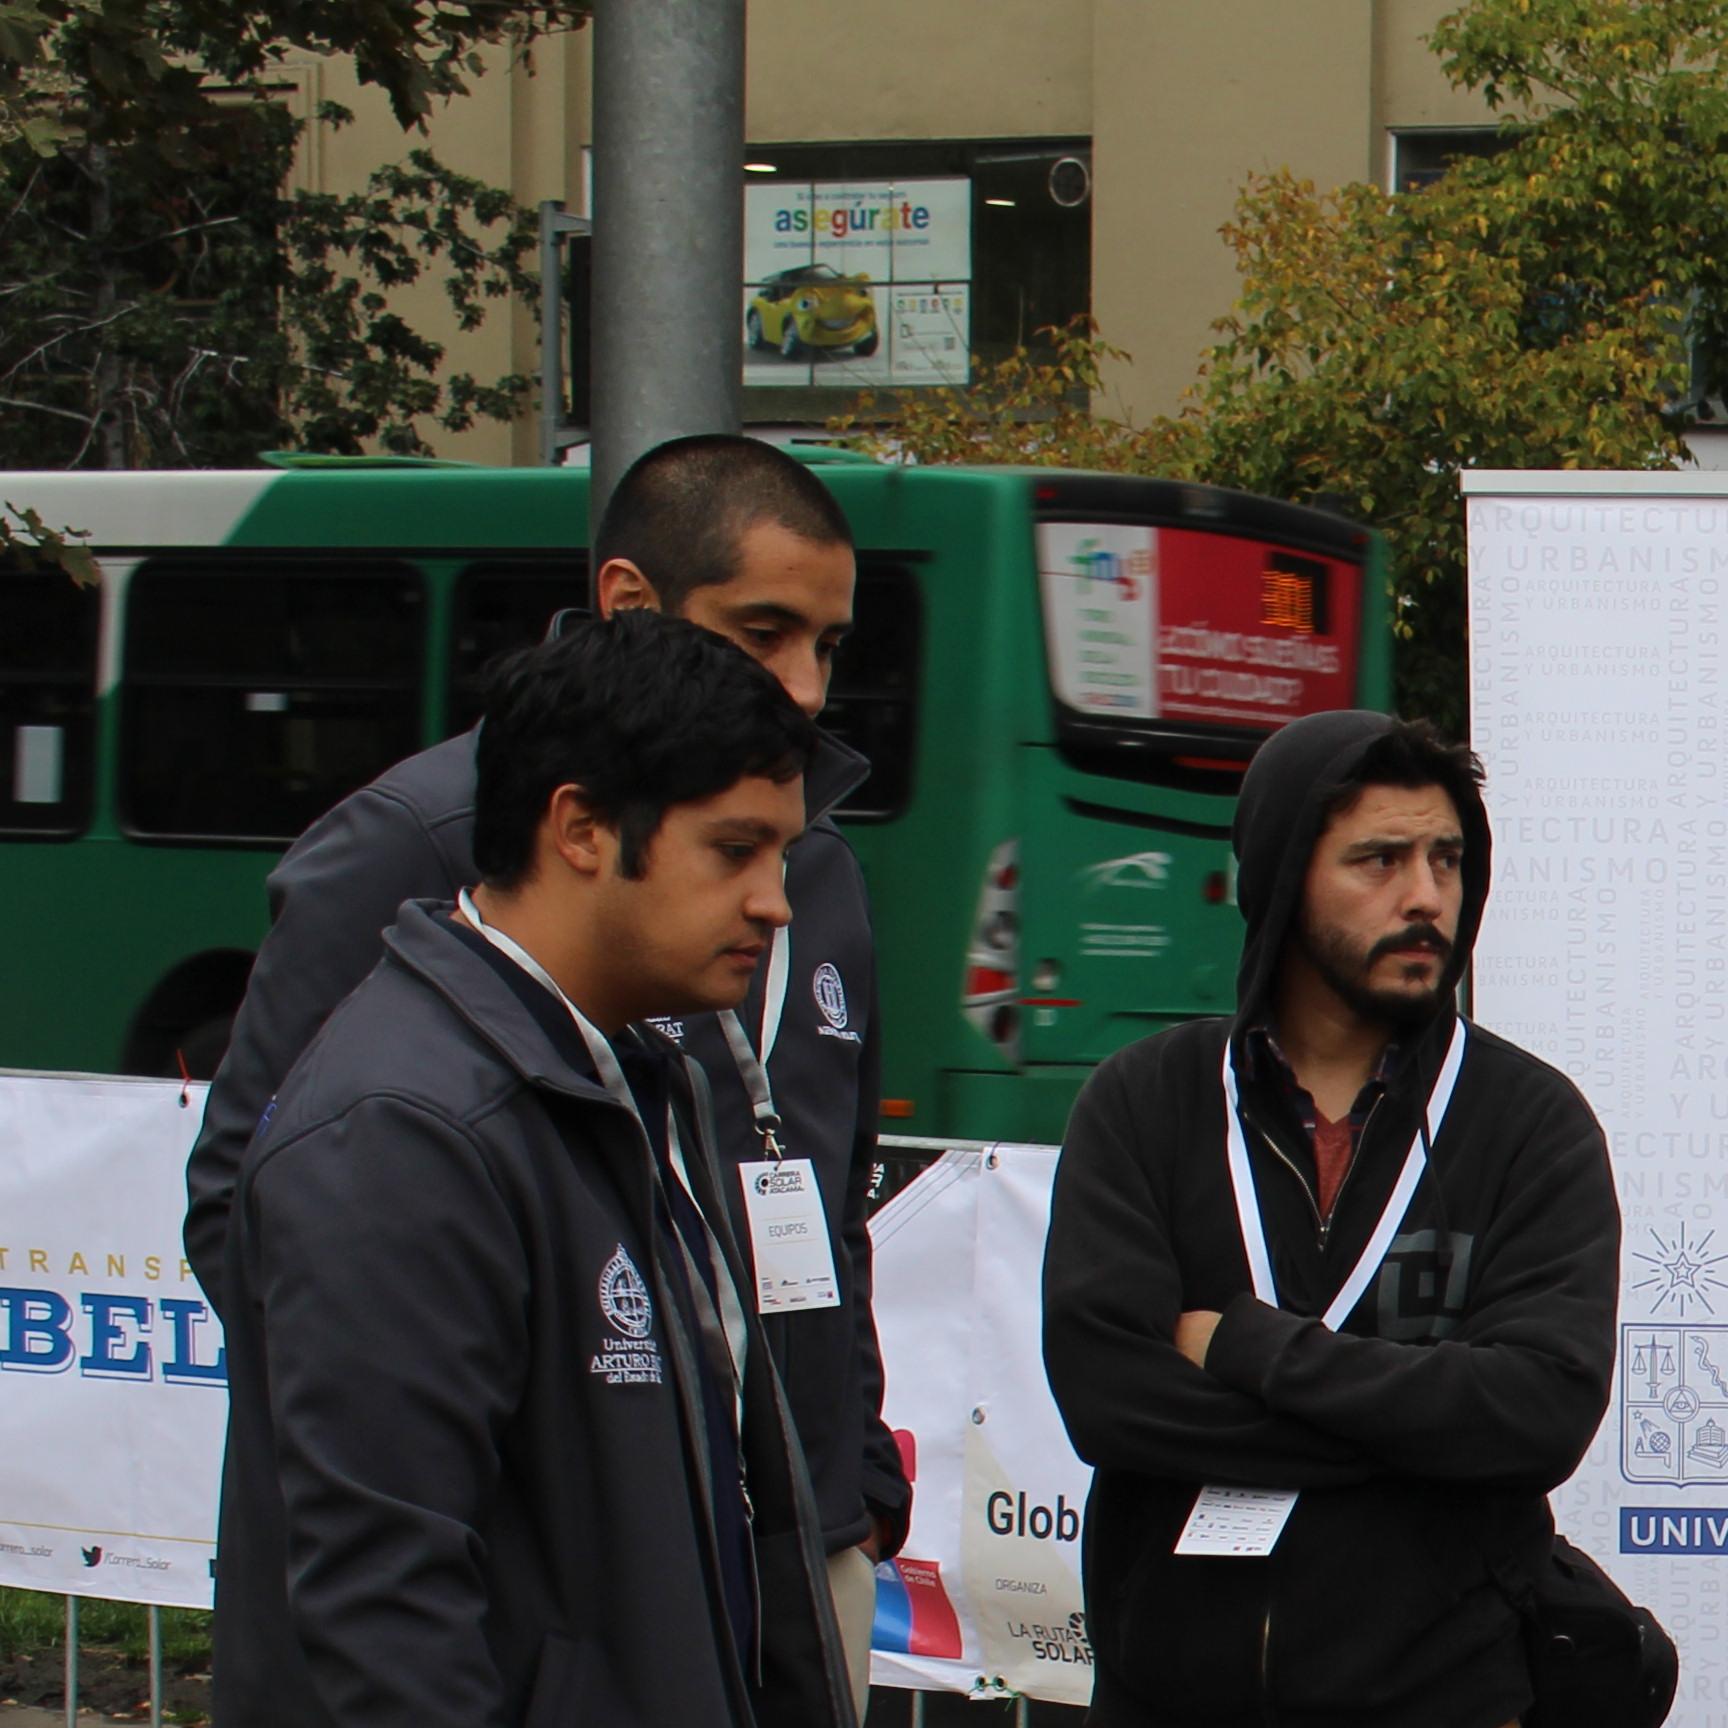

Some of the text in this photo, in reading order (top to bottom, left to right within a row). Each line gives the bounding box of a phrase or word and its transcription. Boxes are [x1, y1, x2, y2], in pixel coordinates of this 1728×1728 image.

[775, 201, 930, 237] asegúrate
[1469, 544, 1486, 572] Y
[1500, 793, 1519, 807] Y
[1696, 793, 1717, 809] Y
[656, 1021, 684, 1037] RAT
[1704, 1036, 1725, 1051] Y
[1669, 1093, 1689, 1120] Y
[769, 1177, 802, 1187] SOLAR
[768, 1222, 808, 1238] EQUIPOS
[0, 1286, 230, 1390] BEL
[590, 1354, 648, 1370] ARTURO
[986, 1490, 1081, 1542] Glob
[995, 1578, 1048, 1595] ORGANIZA
[1007, 1621, 1076, 1643] LA RUTA
